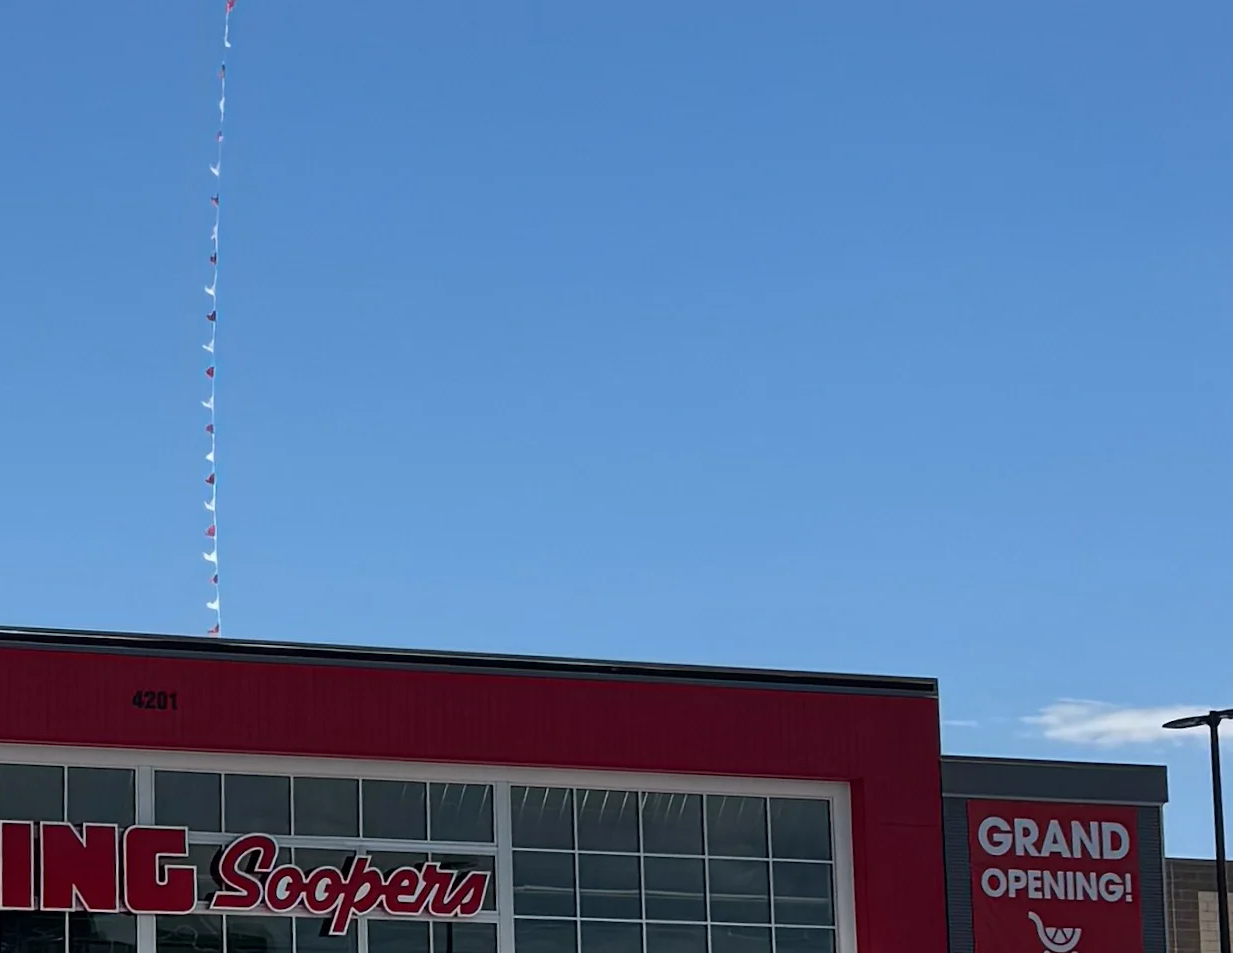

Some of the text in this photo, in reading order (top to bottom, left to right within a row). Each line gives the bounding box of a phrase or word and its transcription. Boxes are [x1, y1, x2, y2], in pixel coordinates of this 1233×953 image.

[132, 690, 178, 711] 4201
[978, 816, 1130, 860] GRAND
[210, 833, 491, 936] Soopers
[981, 868, 1133, 902] OPENING!
